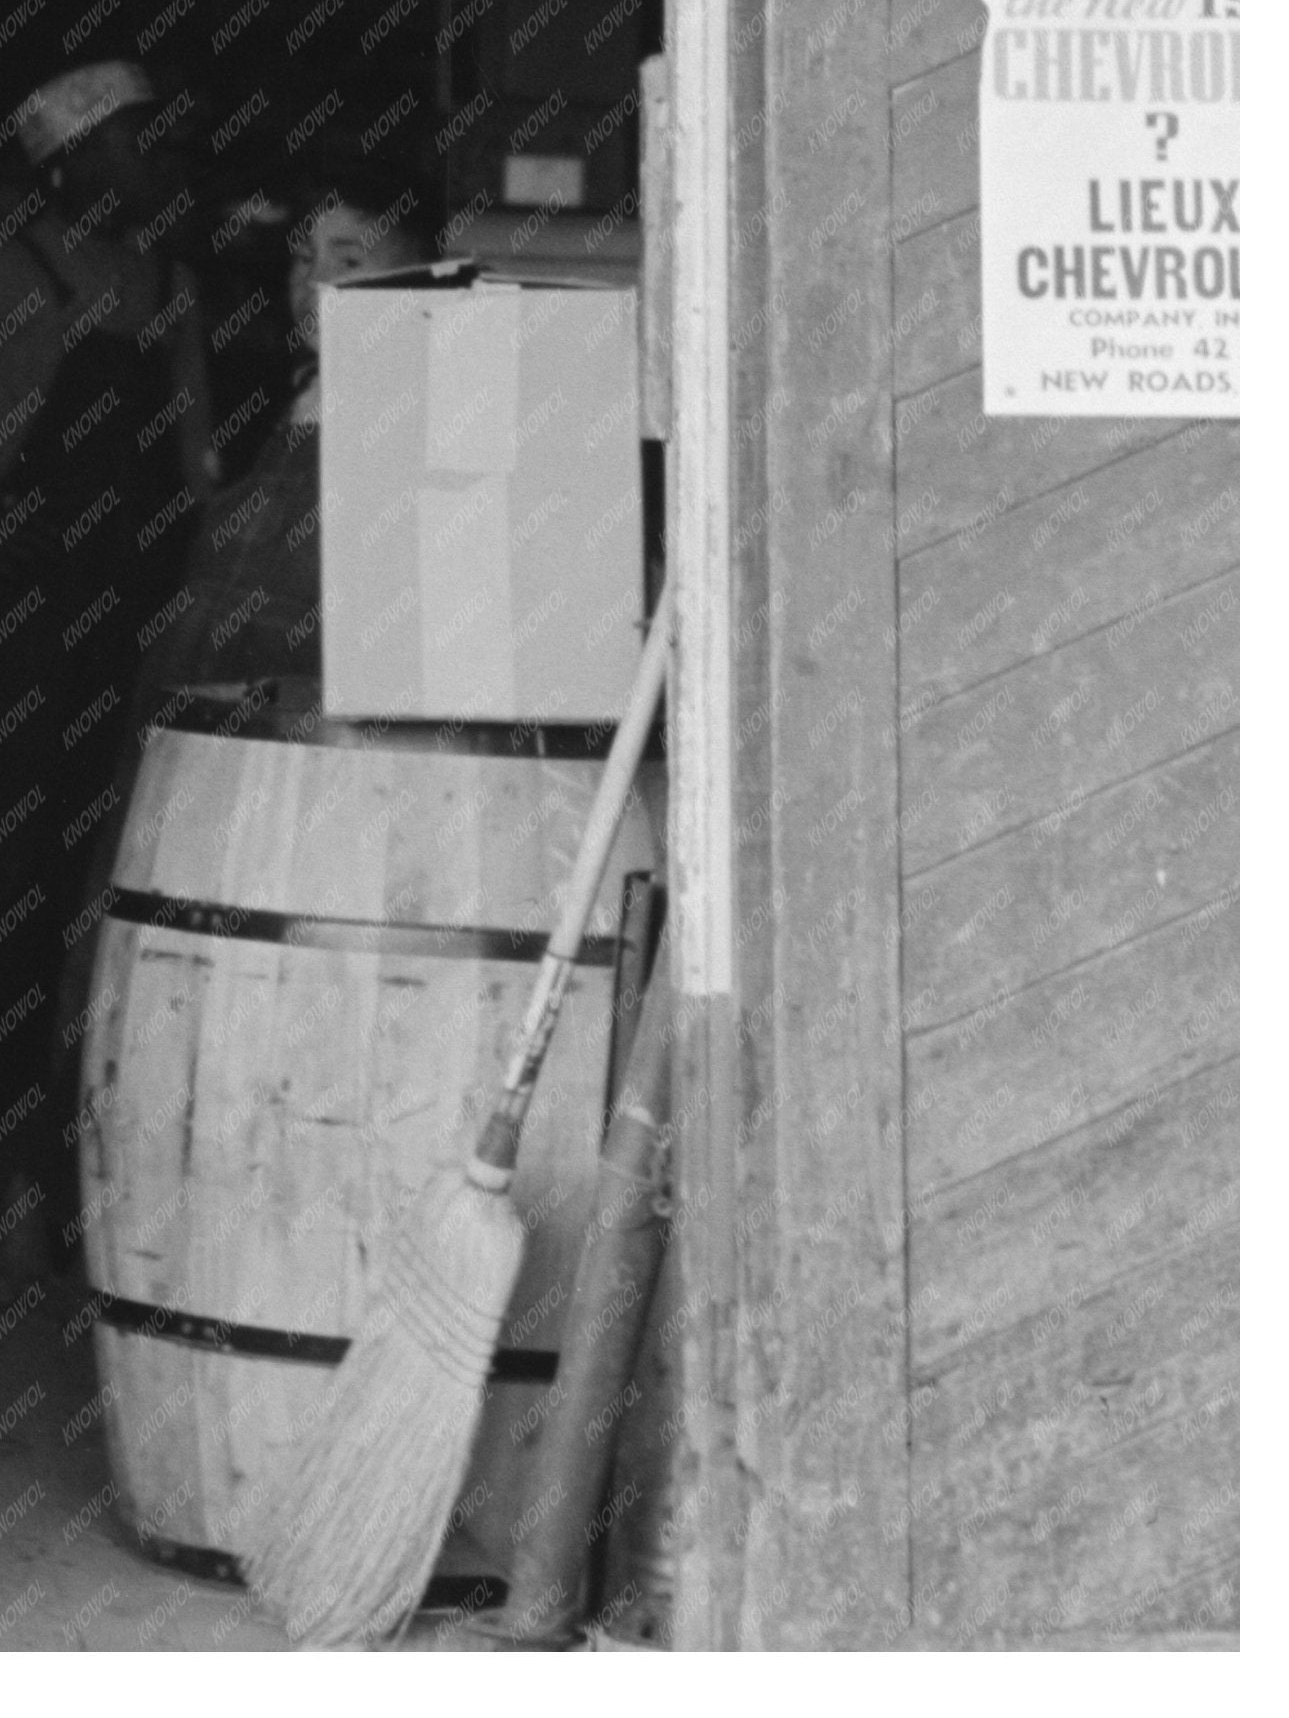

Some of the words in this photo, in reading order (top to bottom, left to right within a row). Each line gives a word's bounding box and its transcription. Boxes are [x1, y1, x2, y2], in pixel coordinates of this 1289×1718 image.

[993, 28, 1239, 103] CHEVRO
[1145, 111, 1179, 162] ?
[1089, 179, 1239, 233] LIEUX
[1092, 336, 1175, 359] Phone
[1194, 337, 1229, 360] 42
[1041, 369, 1109, 393] NEW
